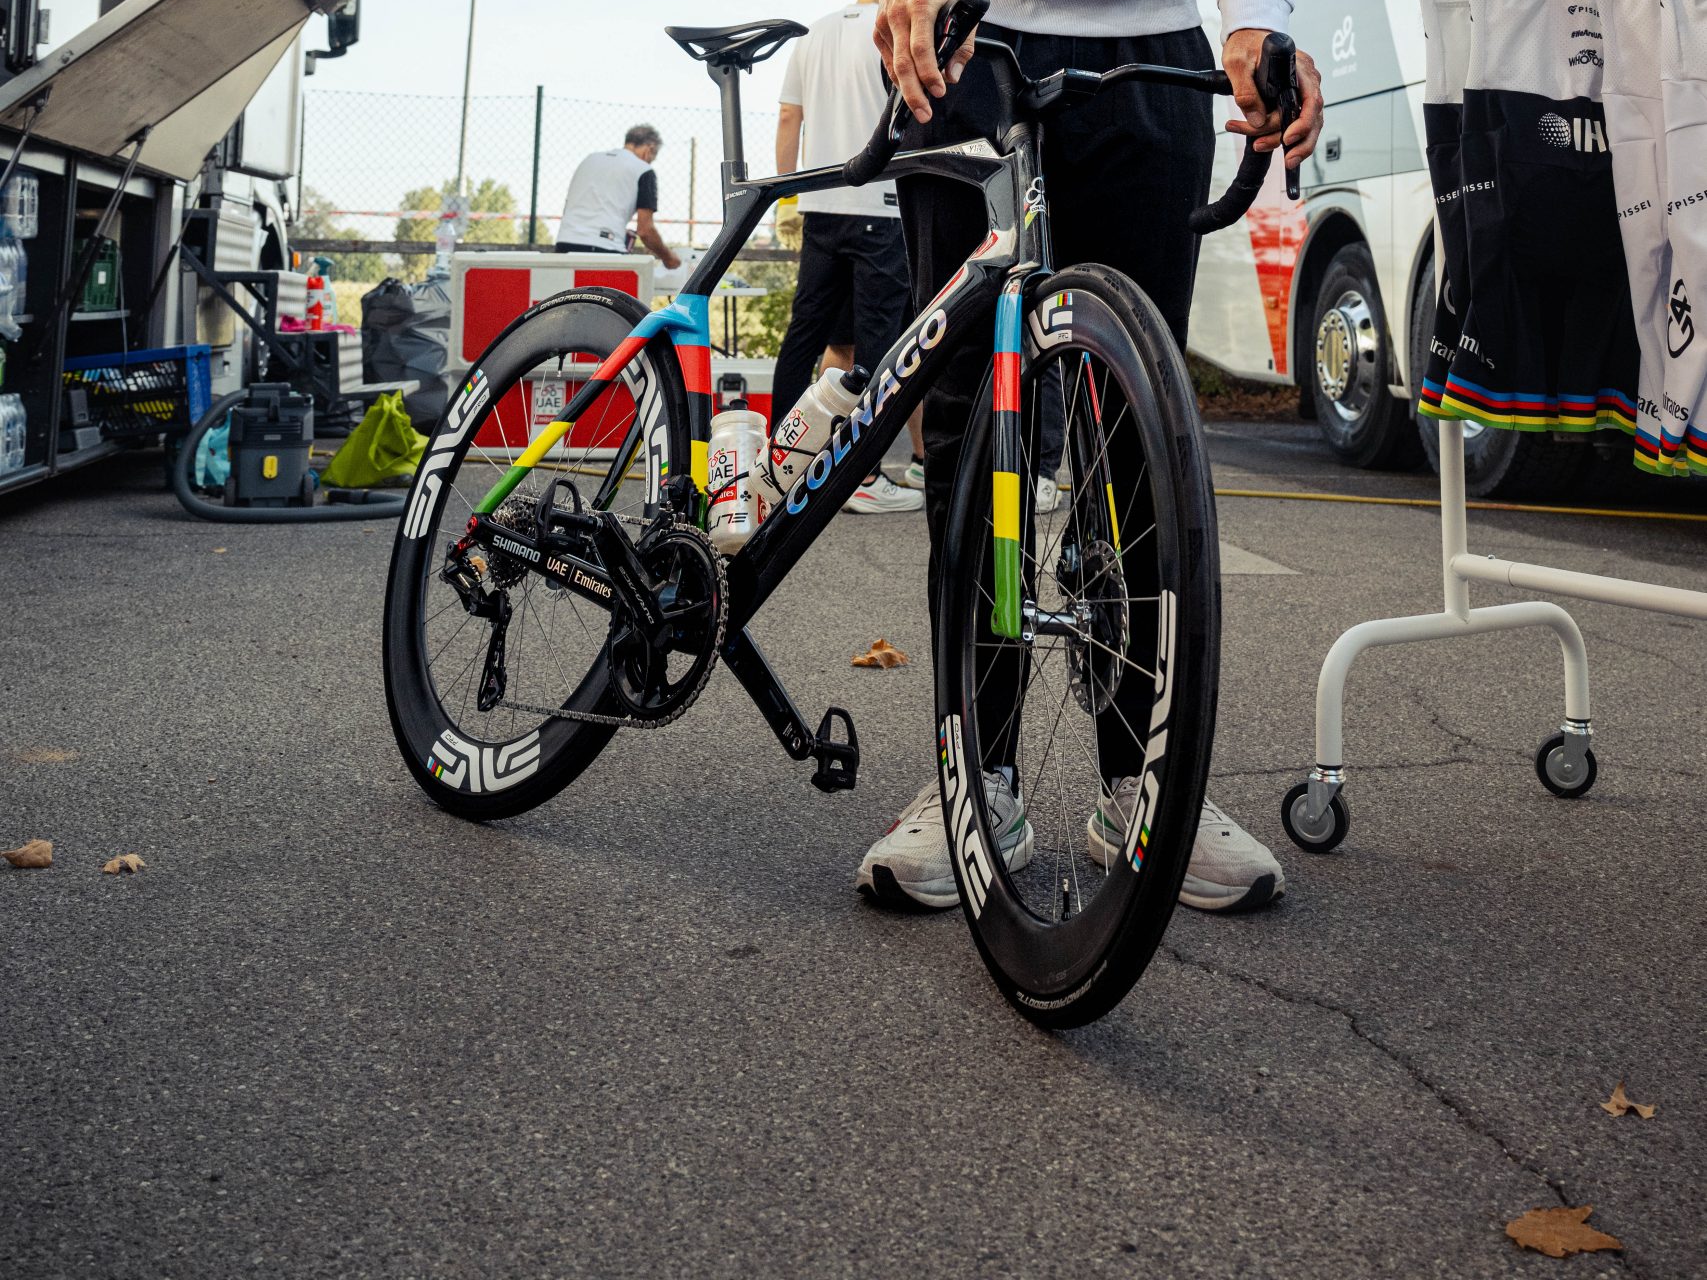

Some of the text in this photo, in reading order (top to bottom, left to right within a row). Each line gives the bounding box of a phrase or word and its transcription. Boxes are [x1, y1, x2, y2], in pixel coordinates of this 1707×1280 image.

[1435, 189, 1460, 205] ISSEI
[536, 397, 561, 408] UAE
[786, 308, 947, 515] COLNAGO
[492, 535, 541, 563] SHIMANO
[546, 556, 613, 599] UAE Emirates
